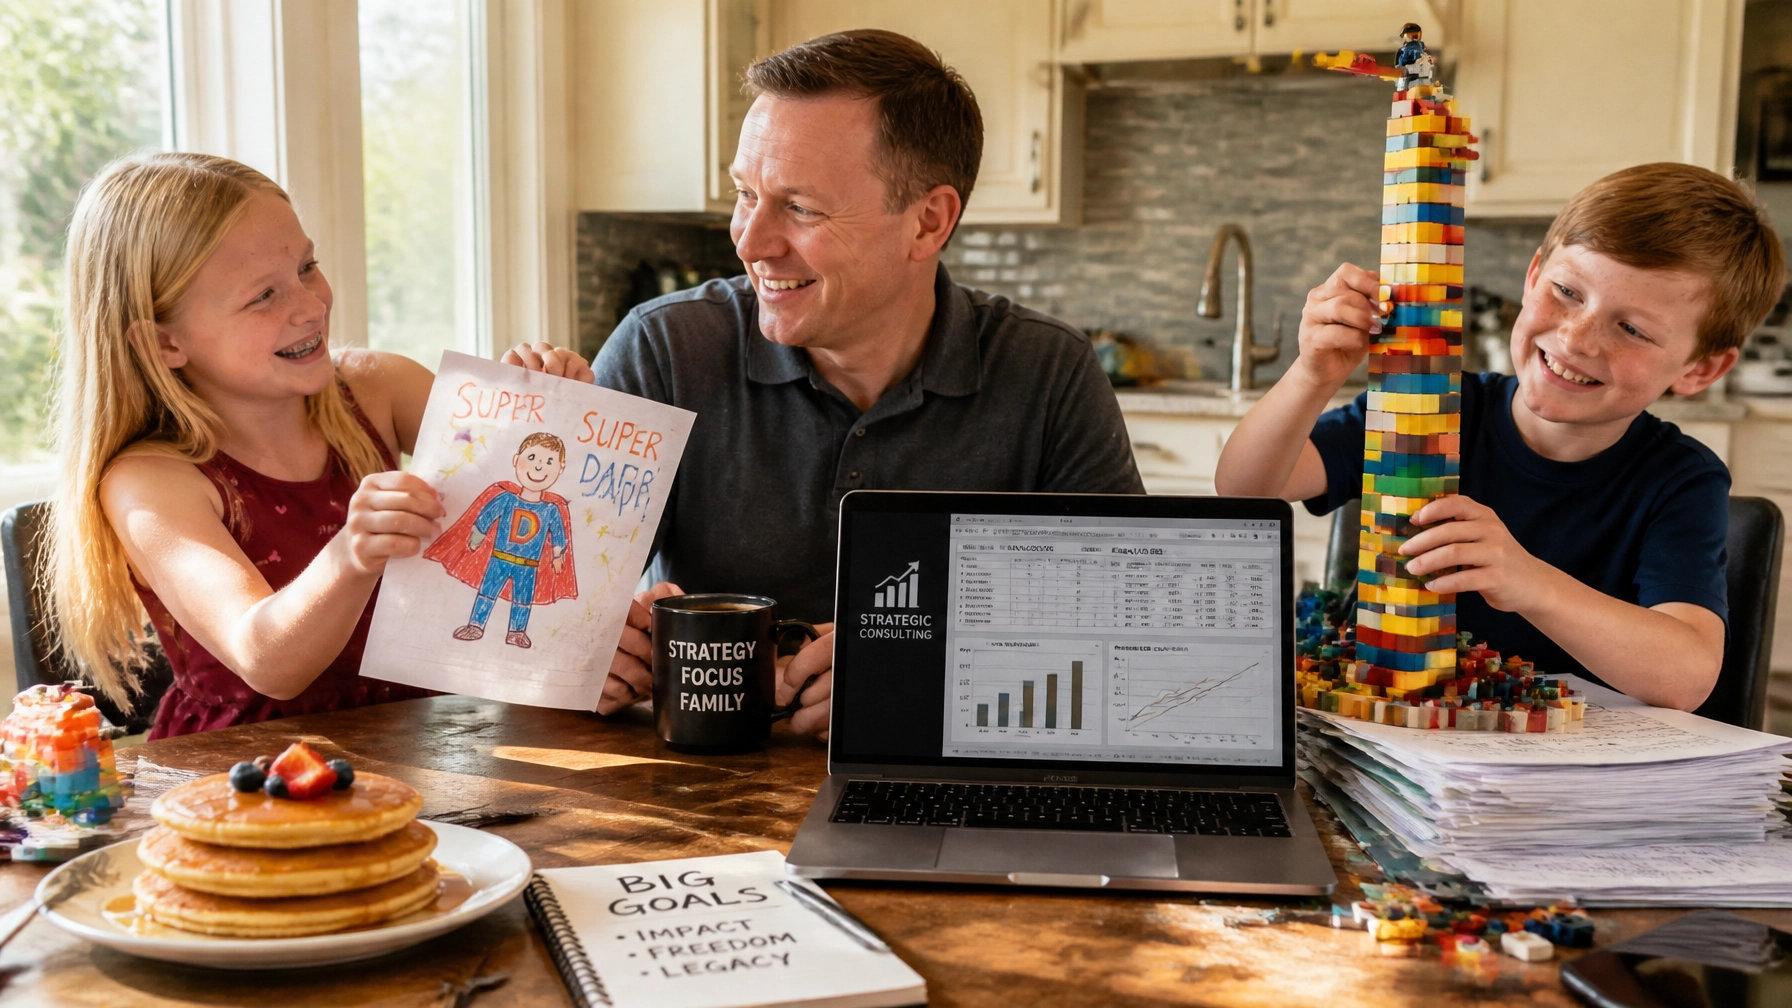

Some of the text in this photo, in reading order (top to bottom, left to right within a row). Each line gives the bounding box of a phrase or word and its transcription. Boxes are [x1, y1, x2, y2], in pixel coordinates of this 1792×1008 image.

[452, 382, 545, 424] SUPER
[577, 410, 663, 461] SUPER
[509, 508, 541, 545] D
[860, 613, 932, 627] STRATEGIC
[859, 628, 932, 640] CONSULTING
[668, 639, 757, 661] STRATEGY
[681, 666, 743, 686] FOCUS
[680, 692, 745, 712] FAMILY
[616, 870, 715, 894] BIG
[608, 887, 768, 916] GOALS
[635, 918, 752, 941] IMPACT
[647, 932, 797, 960] FREEDOM
[659, 952, 792, 978] LEGACY
